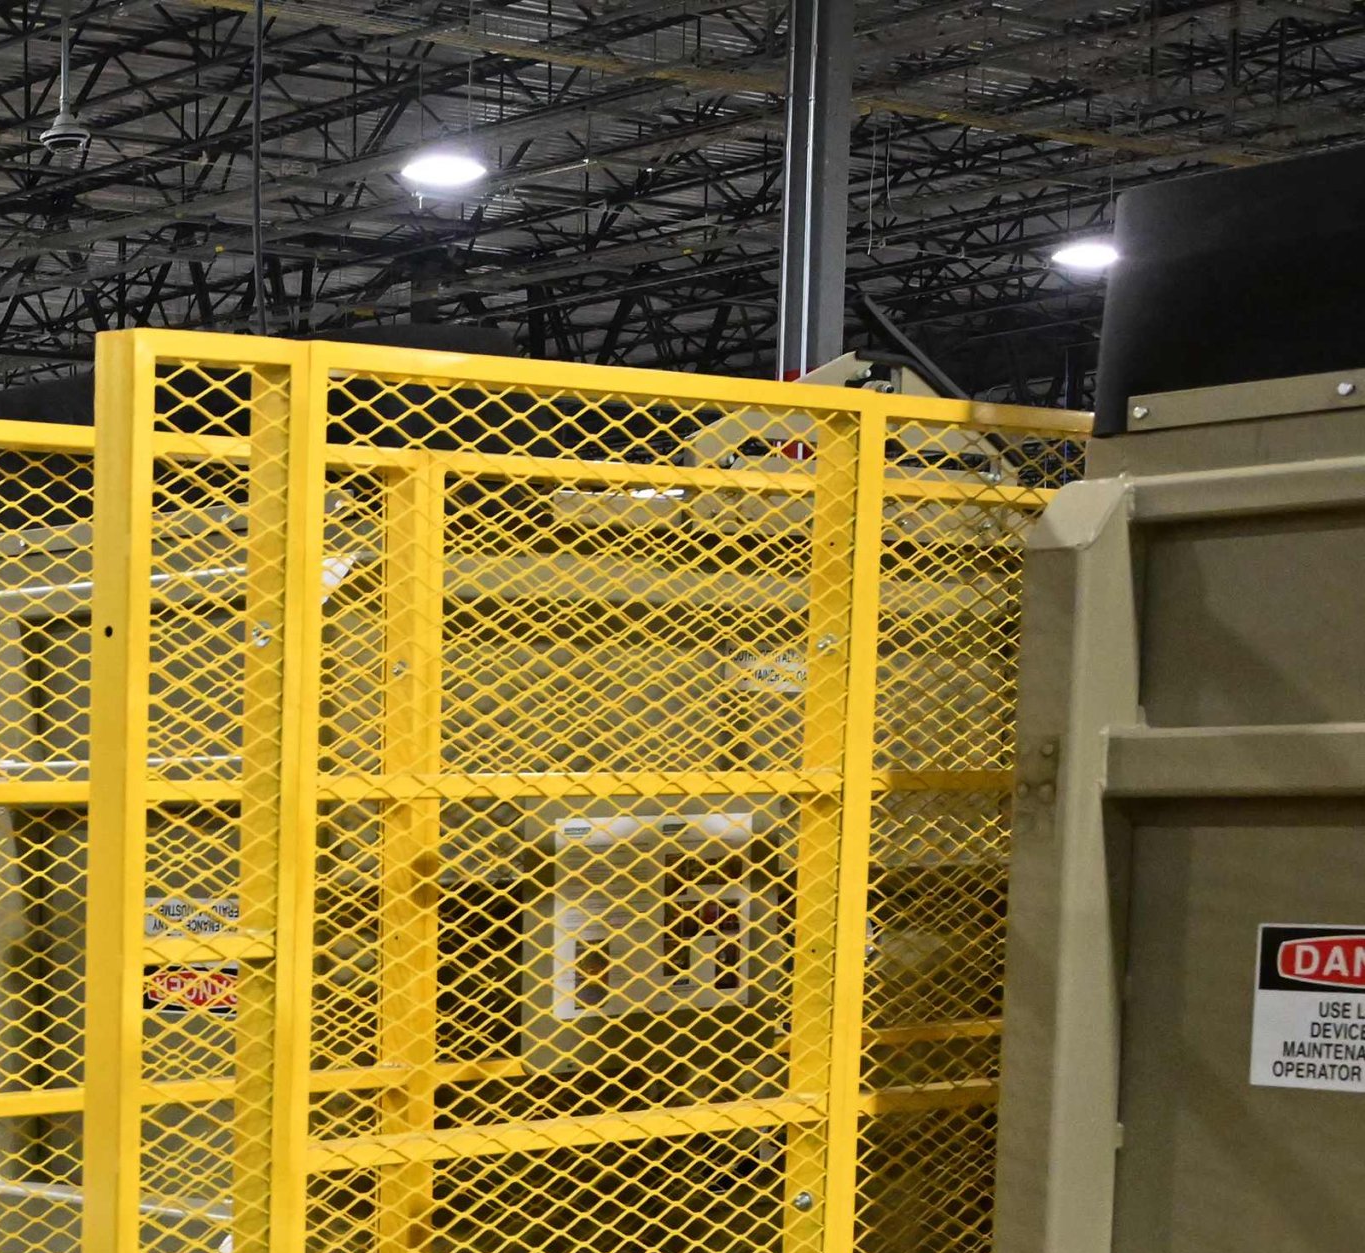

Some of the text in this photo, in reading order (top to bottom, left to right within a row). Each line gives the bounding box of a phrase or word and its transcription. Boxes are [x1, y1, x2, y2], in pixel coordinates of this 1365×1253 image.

[1319, 1001, 1351, 1019] USE
[1282, 1041, 1365, 1061] MAINTENA
[1272, 1060, 1361, 1081] OPERATOR
